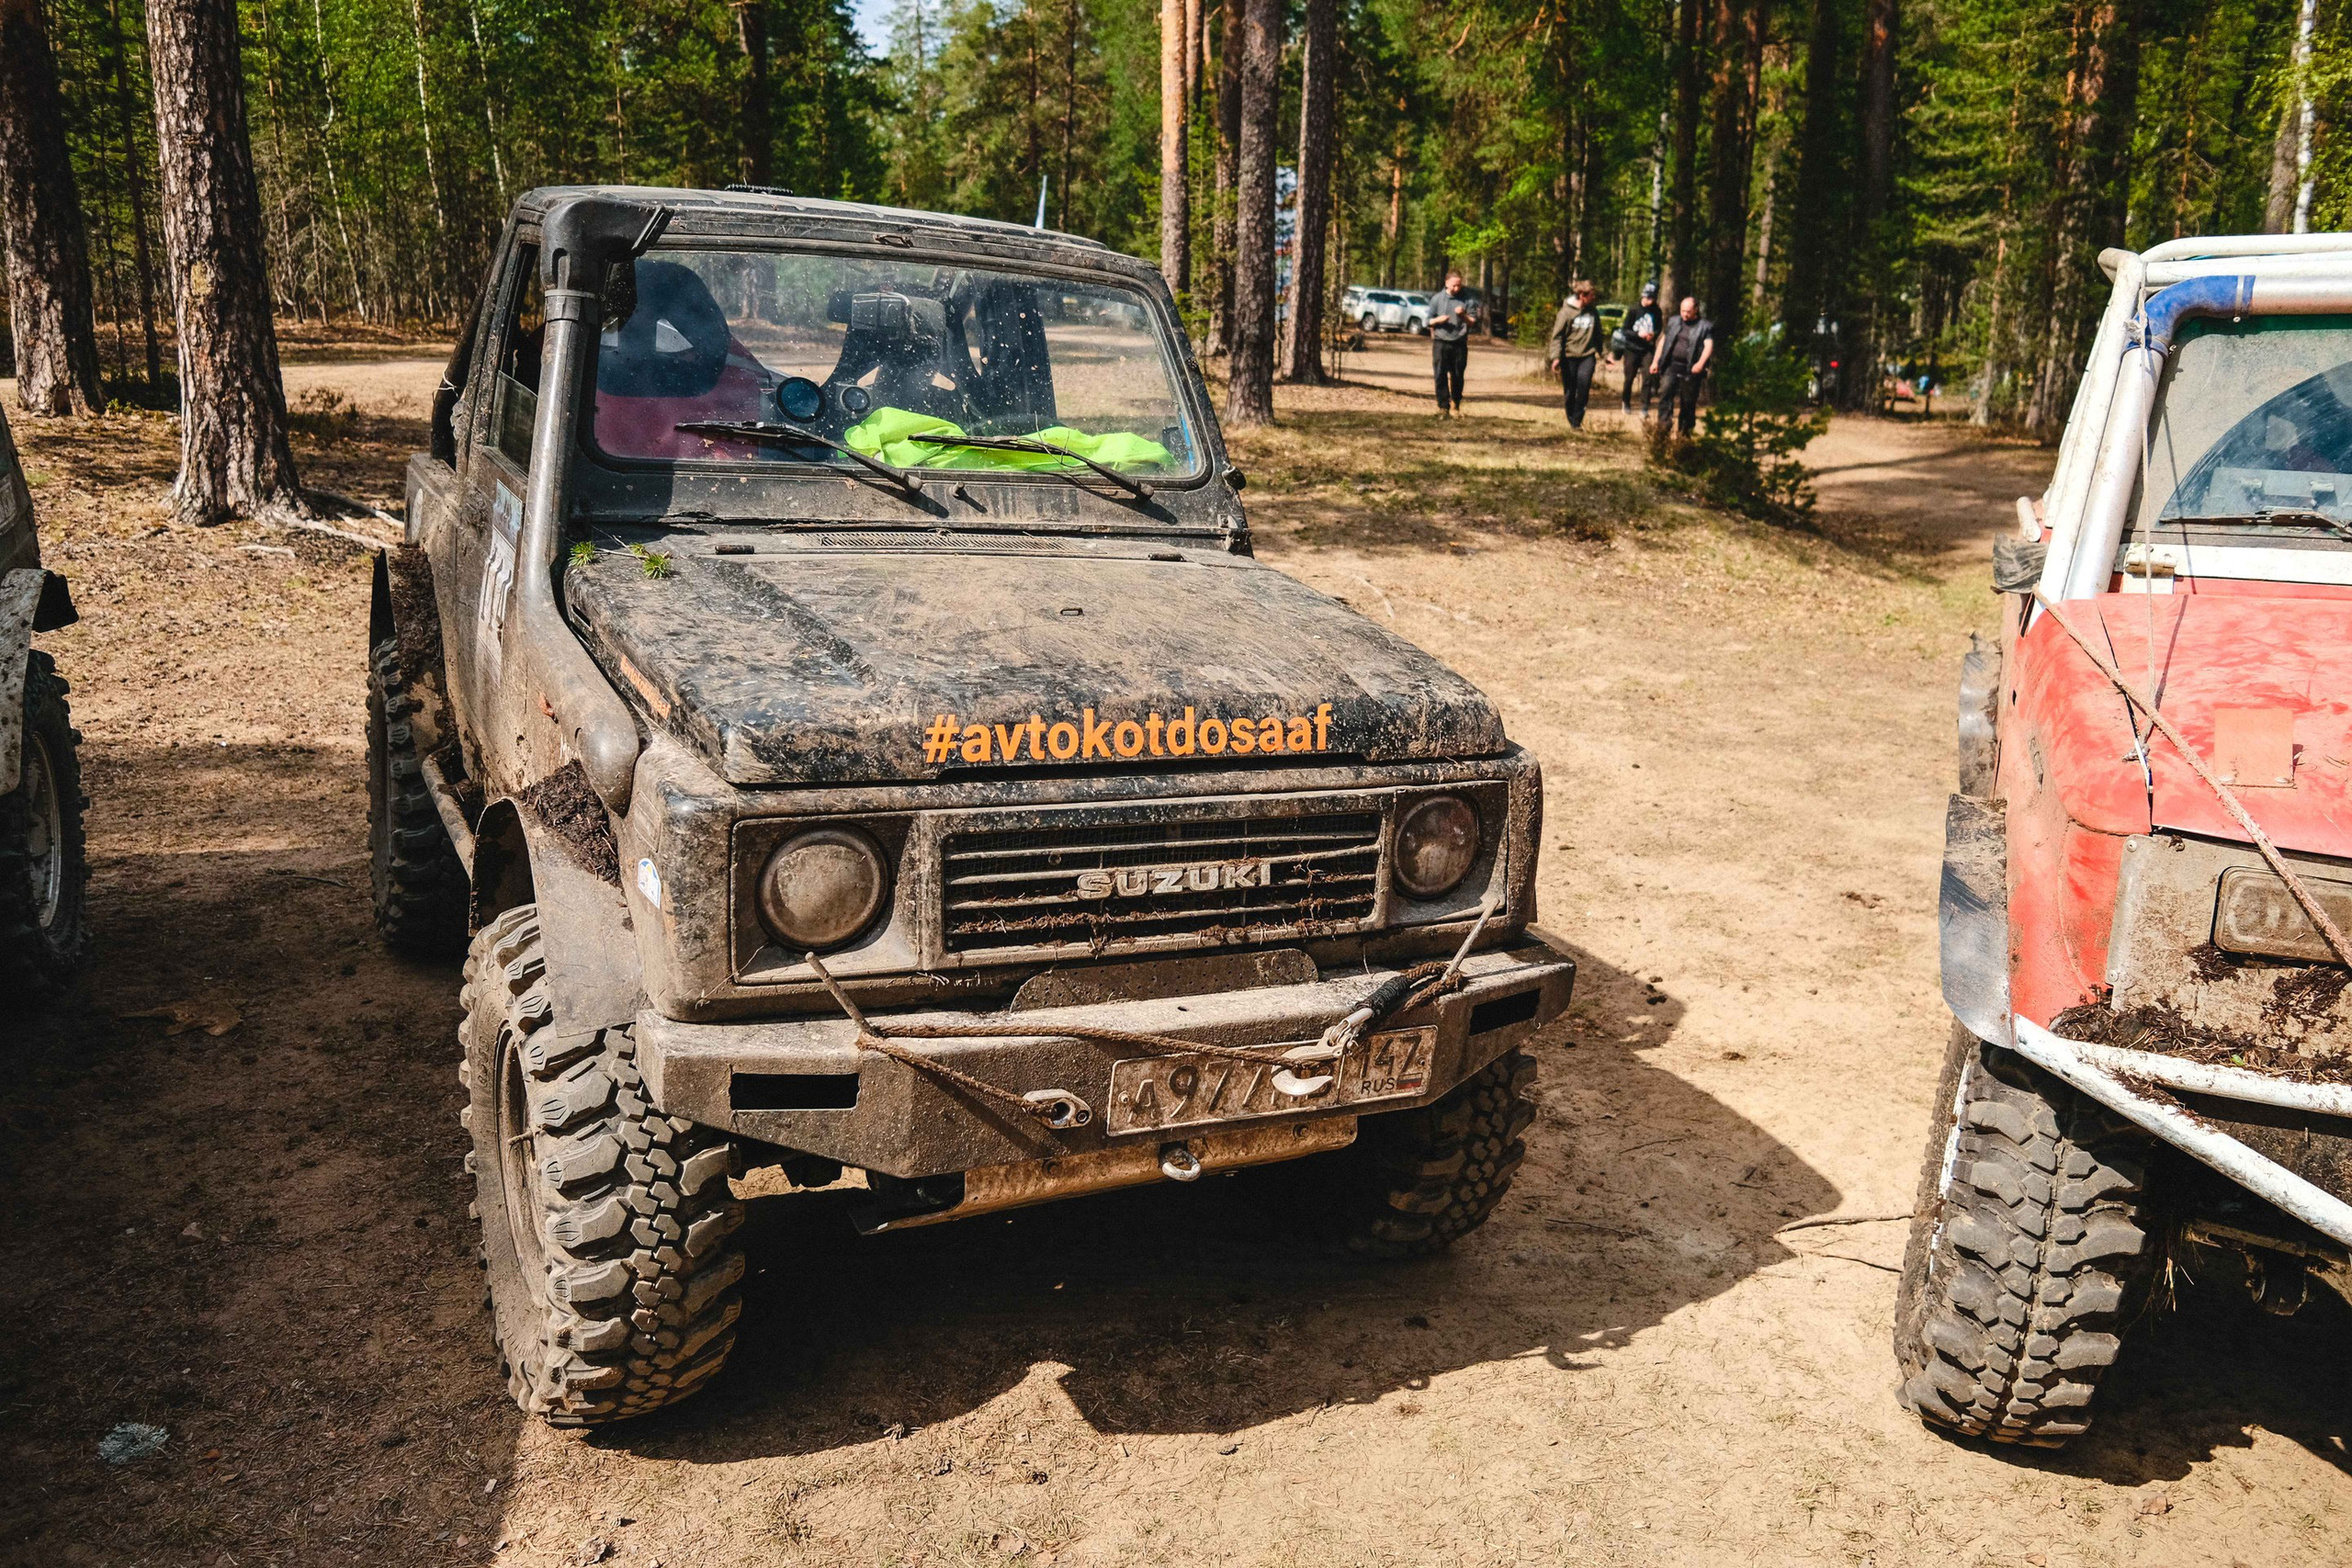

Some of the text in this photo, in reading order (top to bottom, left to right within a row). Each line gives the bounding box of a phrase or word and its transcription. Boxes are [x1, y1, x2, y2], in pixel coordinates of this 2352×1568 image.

[922, 703, 1332, 764] #avtokotdosaaf
[1076, 862, 1272, 901] SUZUKI
[1361, 1077, 1396, 1095] RUS
